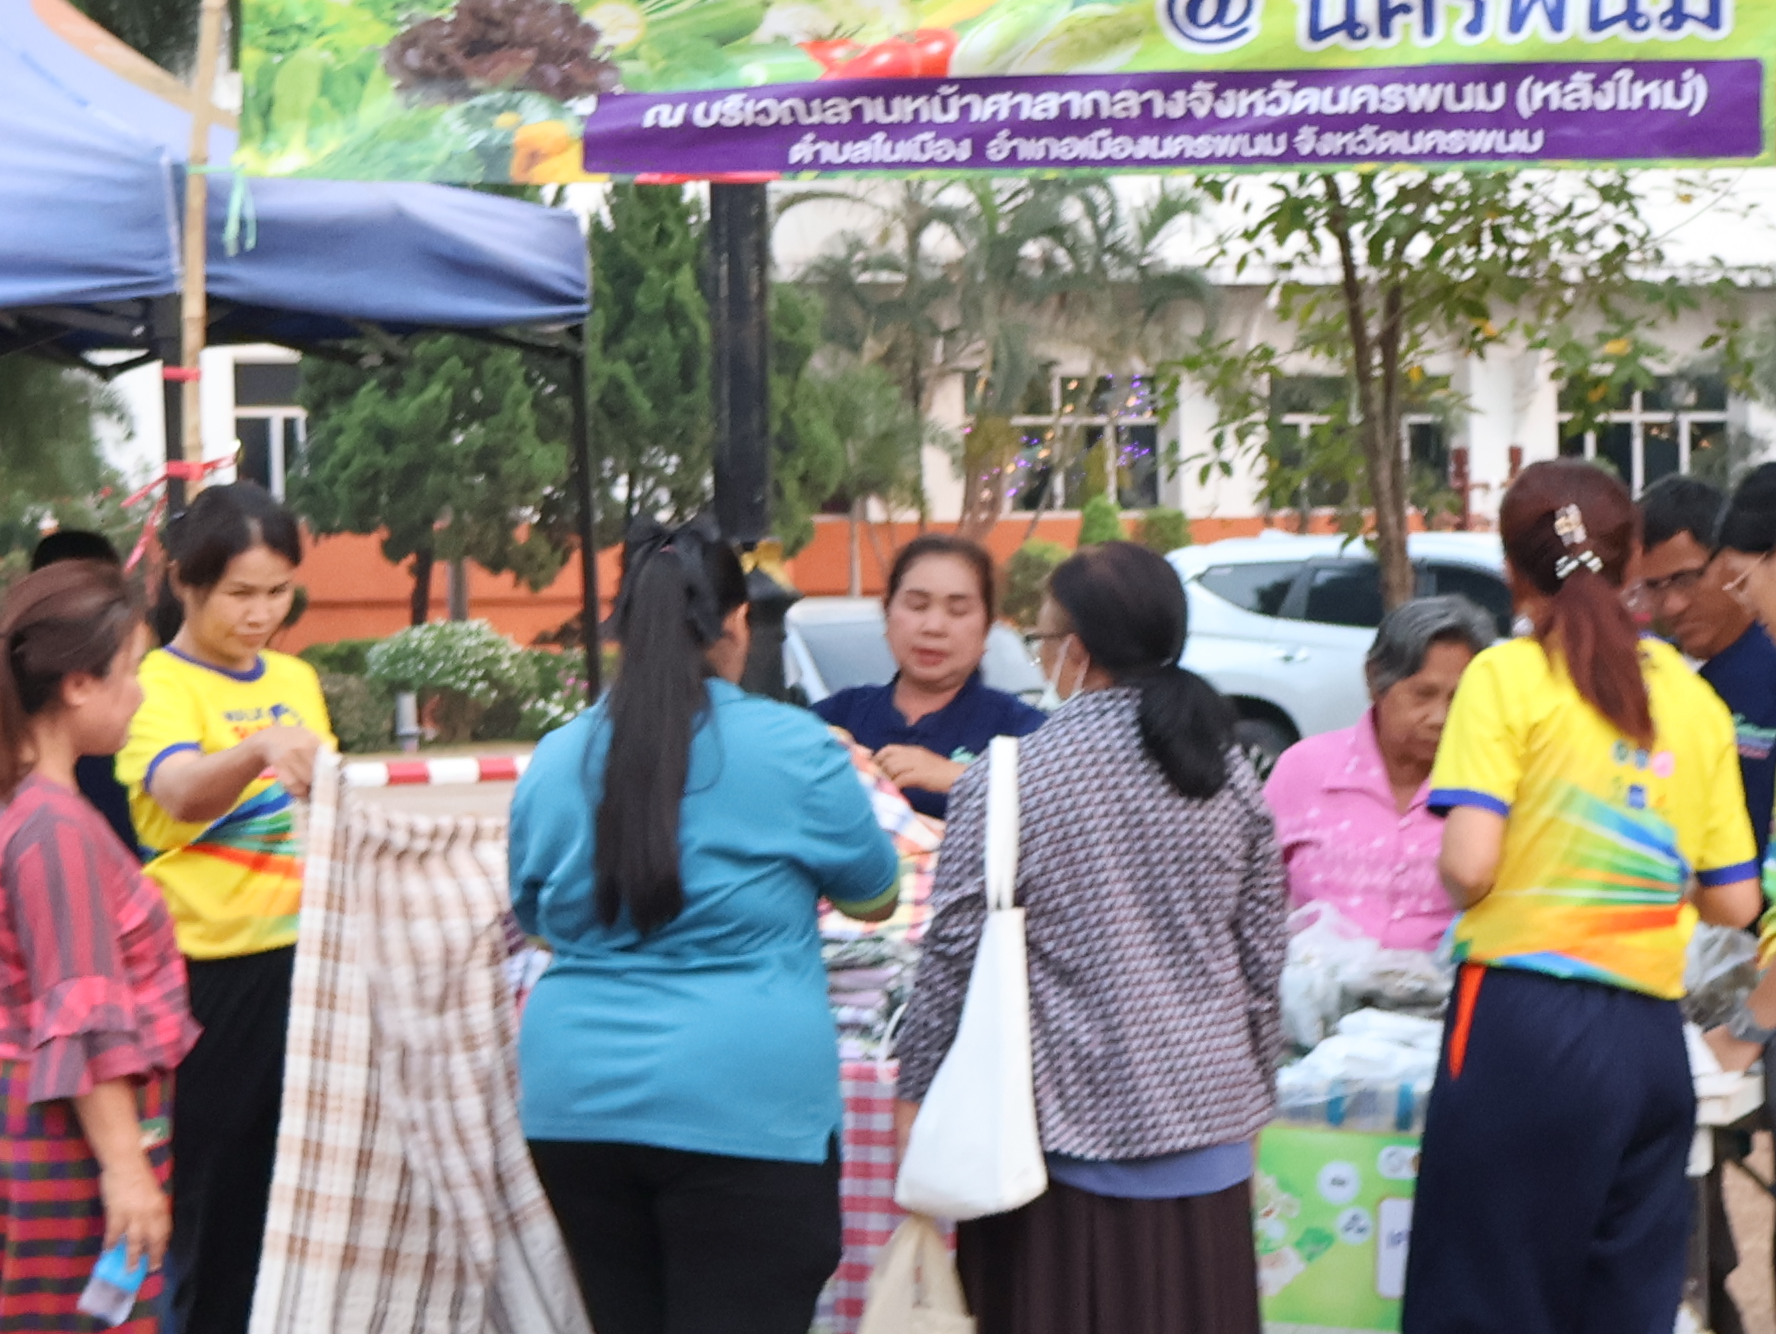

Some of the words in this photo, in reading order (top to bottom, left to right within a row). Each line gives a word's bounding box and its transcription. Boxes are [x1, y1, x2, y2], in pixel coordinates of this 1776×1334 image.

[639, 100, 688, 129] ณ
[691, 77, 1507, 129] บริเวณลานหน้าศาลากลางจังหวัดนครพนม
[1515, 67, 1709, 120] (หลังใหม่)
